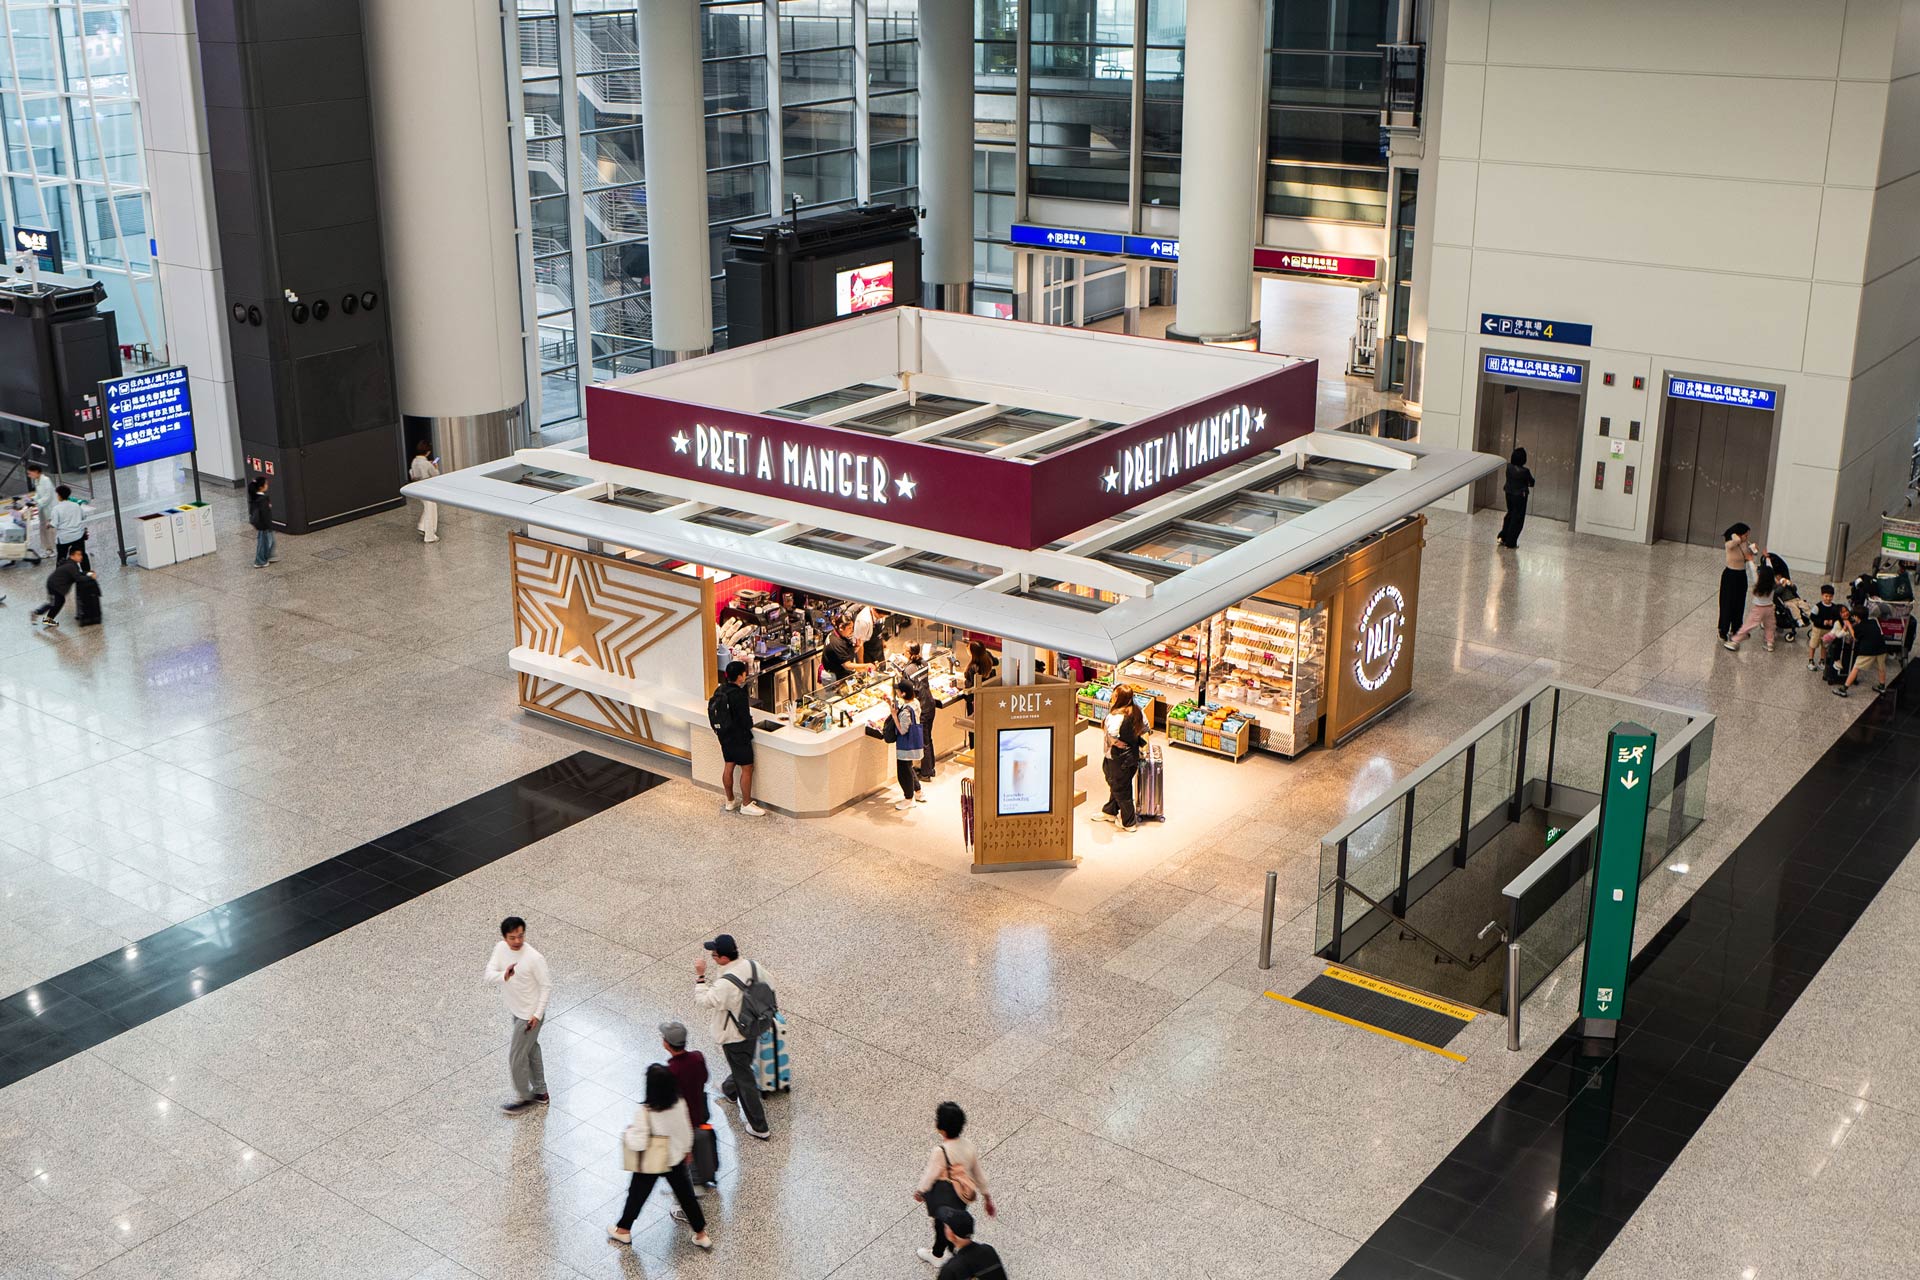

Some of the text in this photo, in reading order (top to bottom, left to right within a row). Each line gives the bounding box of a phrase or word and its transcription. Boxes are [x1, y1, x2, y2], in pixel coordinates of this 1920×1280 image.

[1080, 236, 1086, 246] 4
[1515, 320, 1542, 330] 停車場
[1543, 324, 1553, 338] 4
[1548, 370, 1561, 379] Only)
[1738, 396, 1753, 405] Only)
[1124, 404, 1250, 495] PRET A MANGER
[696, 423, 889, 504] PRET A MANGER
[1360, 587, 1385, 632] ORGANIC
[1366, 612, 1397, 664] PRET
[1374, 666, 1392, 690] MADE
[1390, 635, 1403, 668] FOOD
[1011, 693, 1042, 712] PRET
[1379, 985, 1469, 1018] Please mind the step
